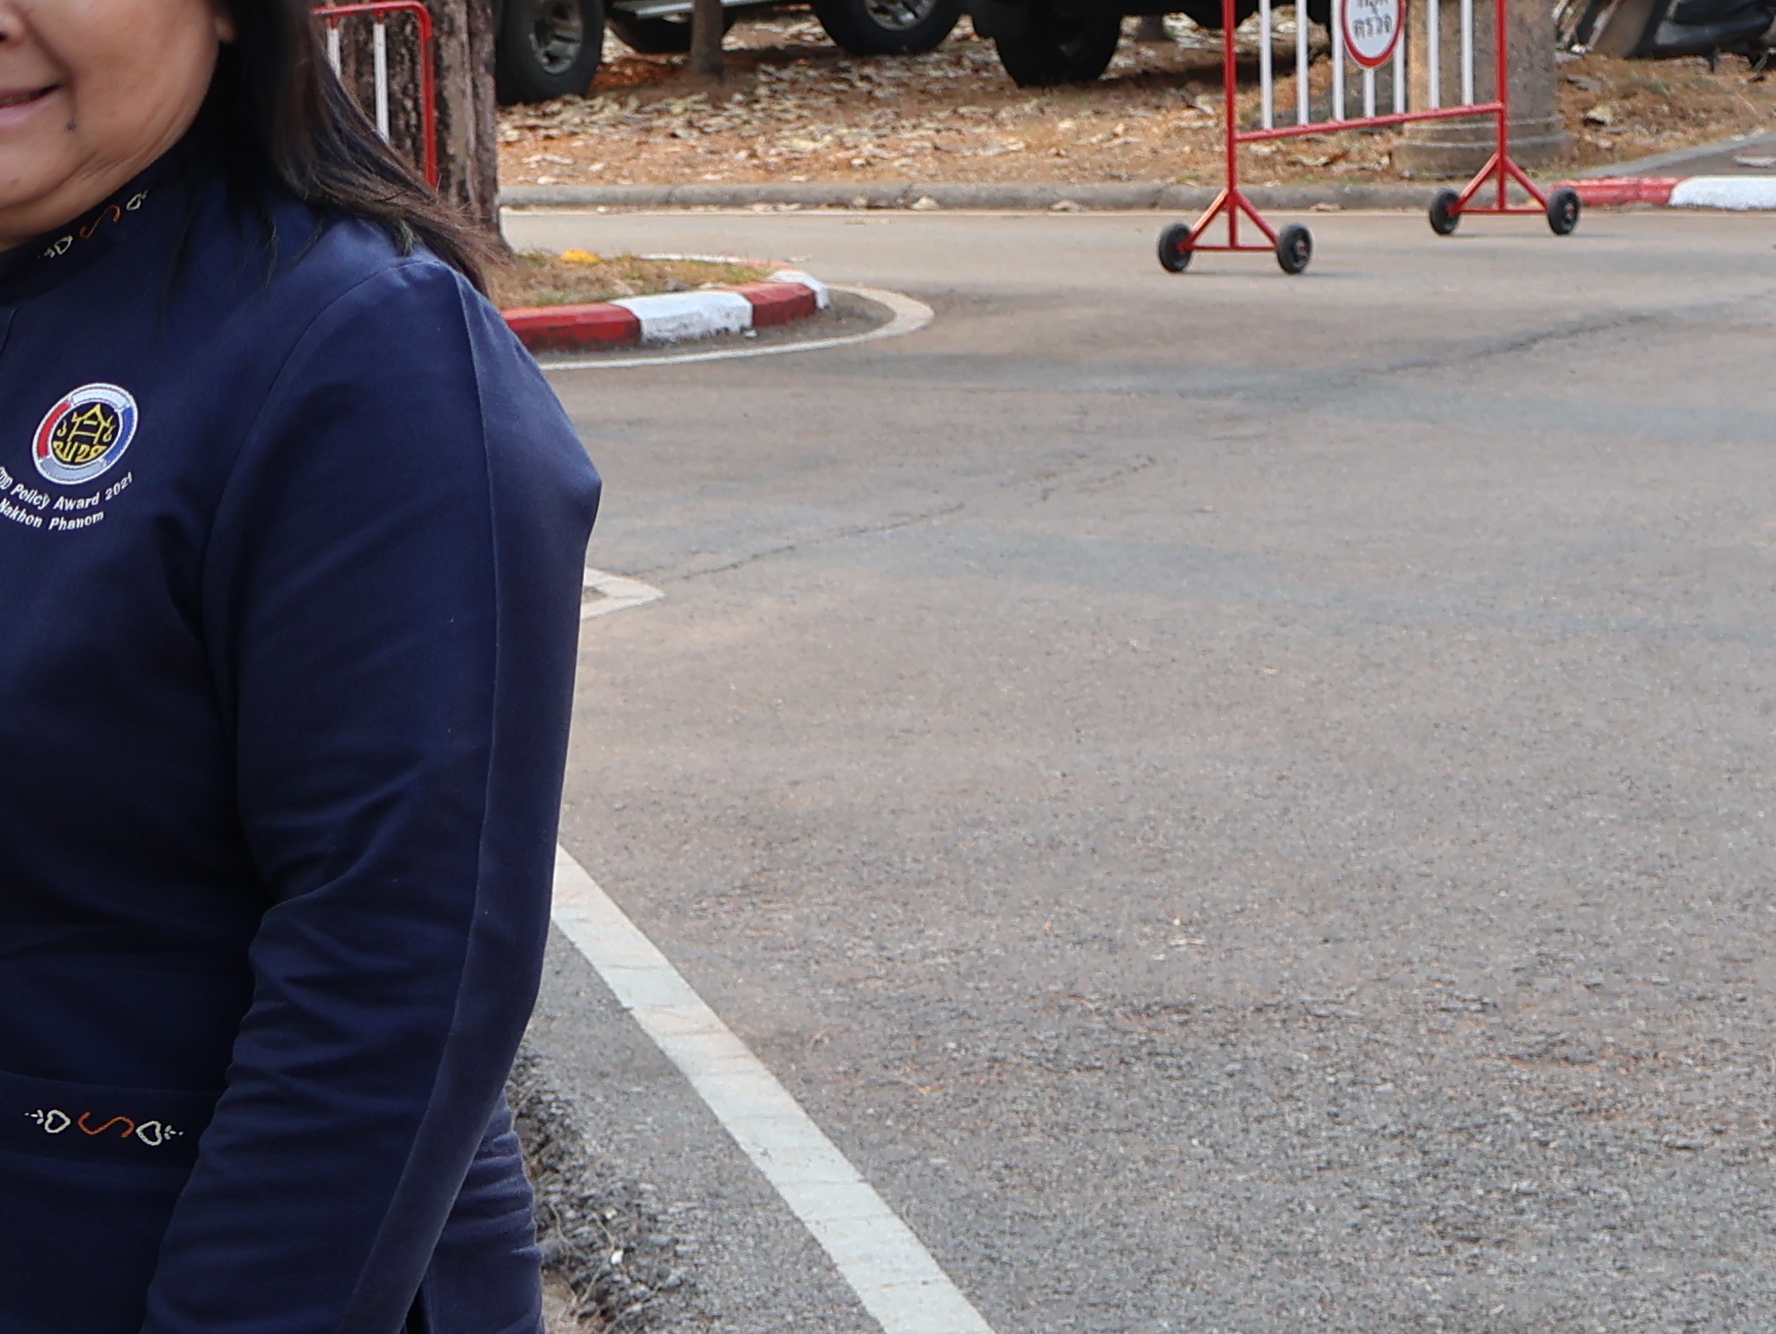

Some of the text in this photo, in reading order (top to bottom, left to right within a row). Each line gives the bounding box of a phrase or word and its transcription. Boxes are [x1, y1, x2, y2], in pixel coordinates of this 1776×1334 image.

[10, 482, 51, 511] Policy
[53, 492, 101, 512] Award
[104, 471, 134, 502] 2021
[48, 511, 105, 532] Phanom
